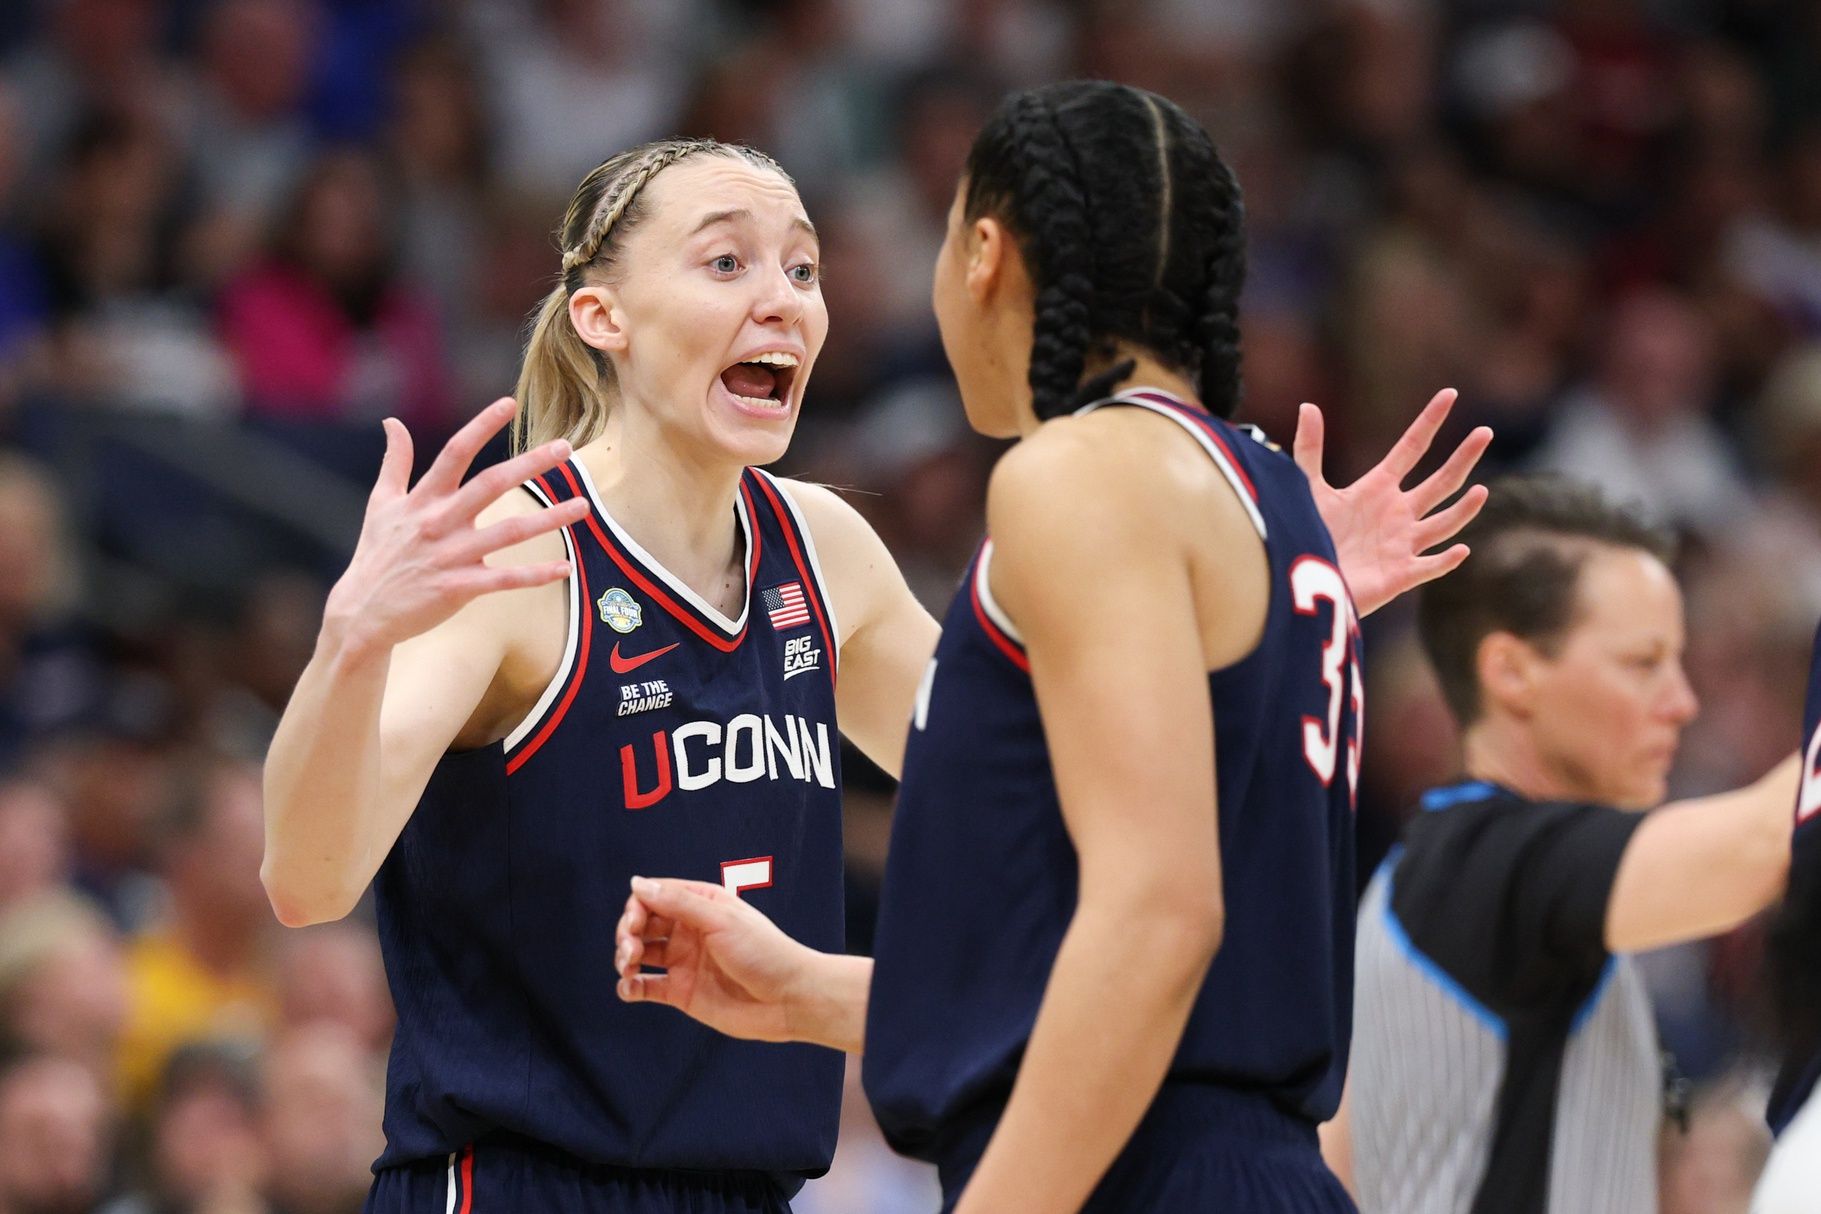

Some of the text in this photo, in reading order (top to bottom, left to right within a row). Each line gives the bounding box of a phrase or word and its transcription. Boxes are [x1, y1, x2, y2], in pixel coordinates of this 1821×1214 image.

[603, 604, 638, 618] FINAL FOUR
[784, 635, 812, 657] BIG
[784, 648, 821, 672] EAST
[620, 679, 669, 700] BE THE
[617, 692, 673, 717] CHANGE
[620, 713, 836, 810] UCONN
